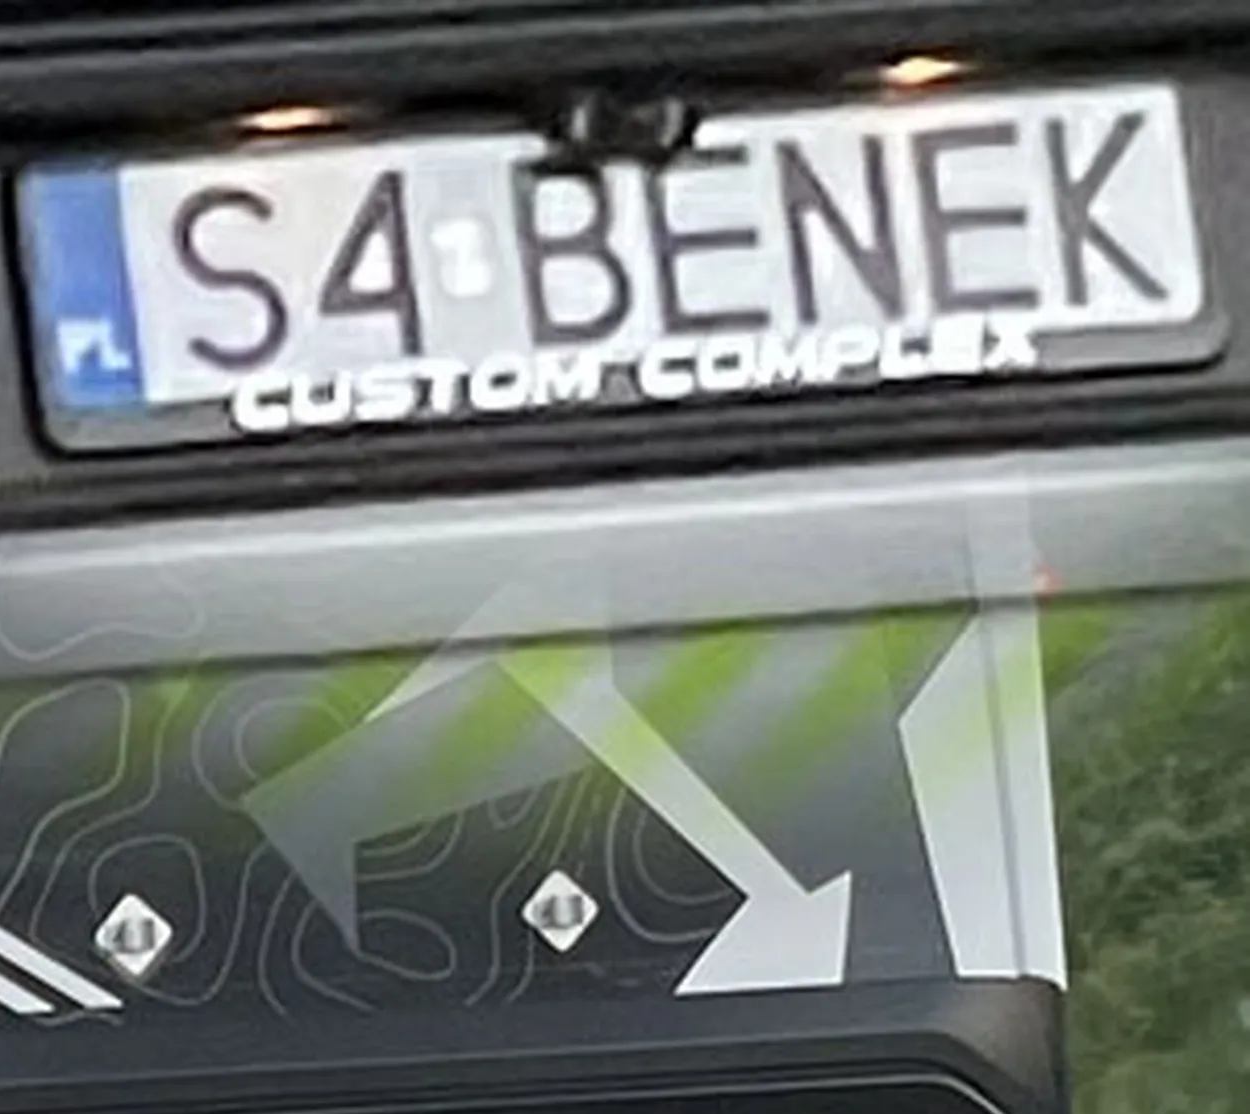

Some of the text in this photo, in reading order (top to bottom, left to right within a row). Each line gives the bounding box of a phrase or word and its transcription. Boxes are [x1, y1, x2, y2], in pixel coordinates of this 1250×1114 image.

[172, 110, 1168, 371] S4 BENEK
[56, 317, 131, 372] PL
[233, 312, 1038, 432] CUSTOM COMPLEX
